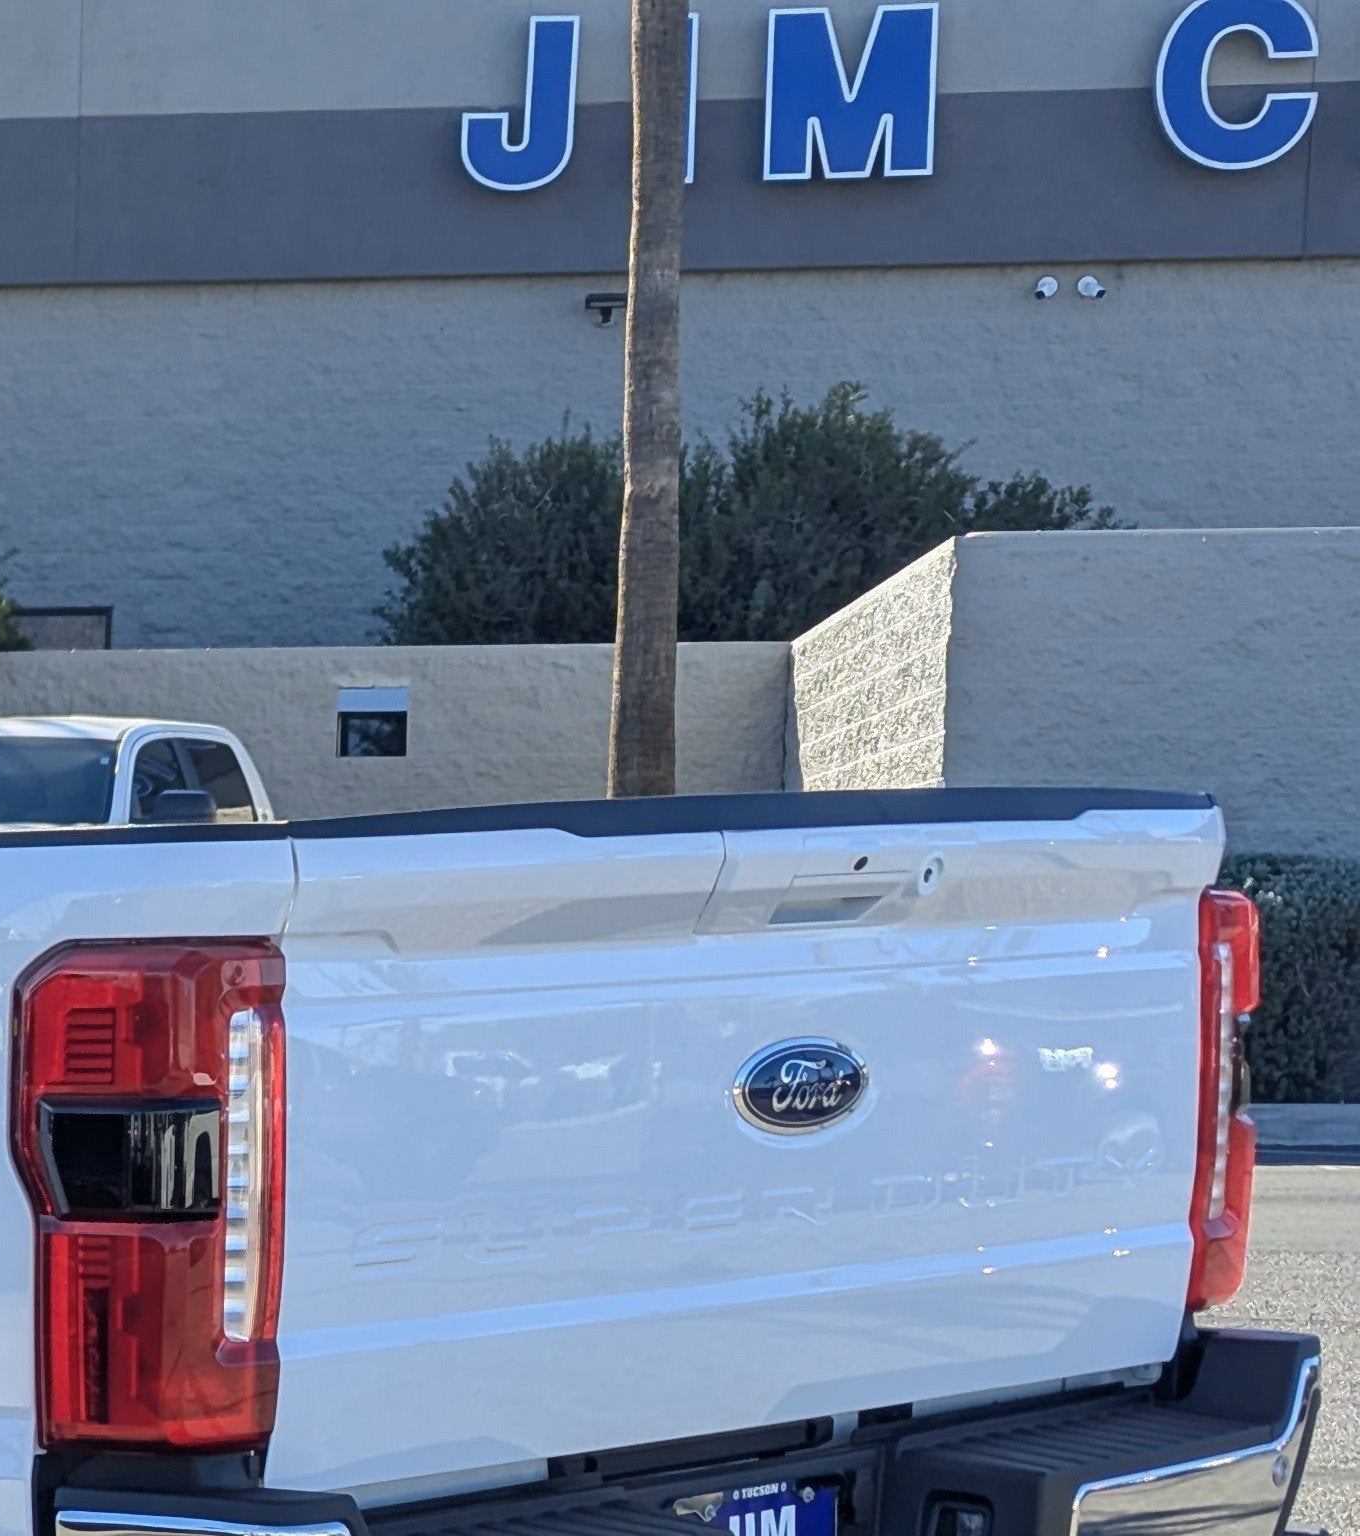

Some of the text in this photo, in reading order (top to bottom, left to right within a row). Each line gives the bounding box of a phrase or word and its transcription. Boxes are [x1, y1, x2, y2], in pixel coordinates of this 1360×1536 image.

[461, 3, 939, 191] JM
[772, 1060, 844, 1112] Ford
[742, 1482, 779, 1500] TUCSON
